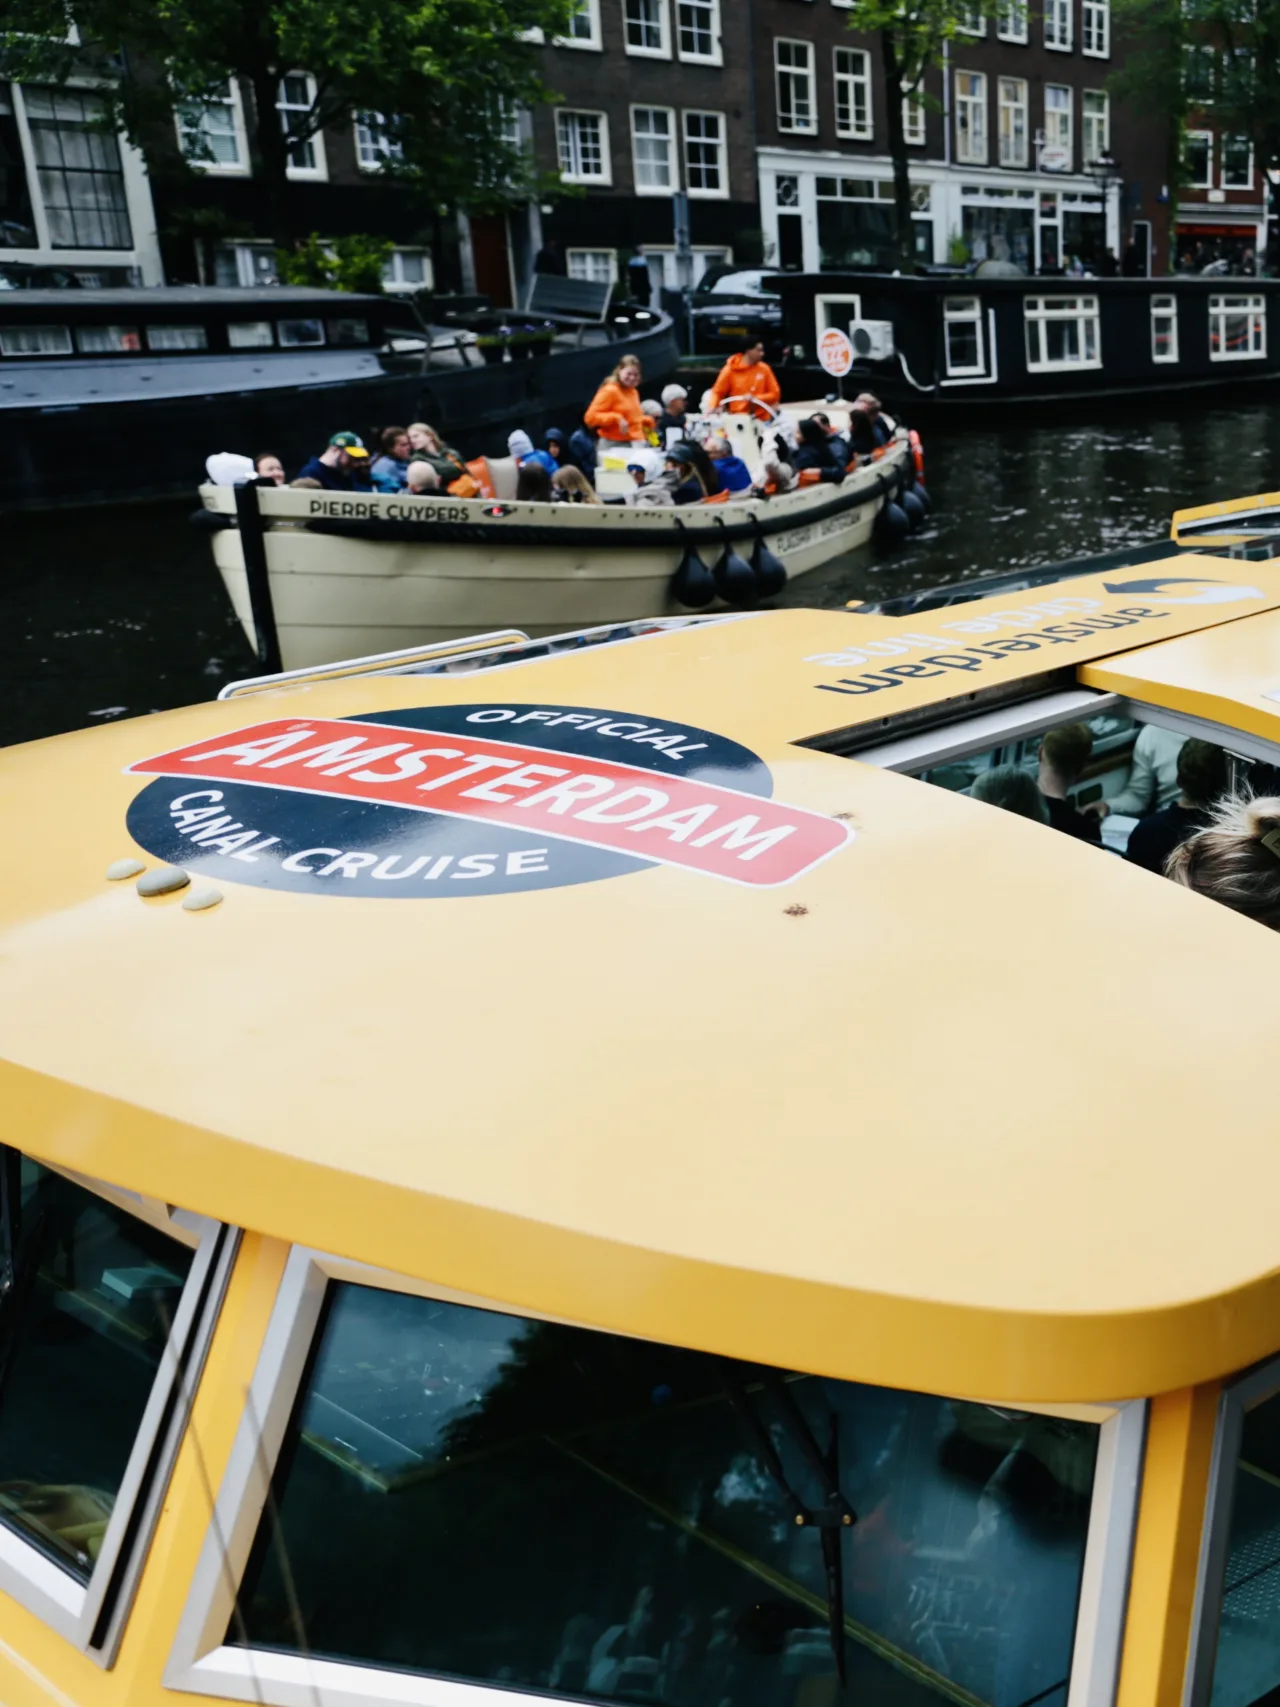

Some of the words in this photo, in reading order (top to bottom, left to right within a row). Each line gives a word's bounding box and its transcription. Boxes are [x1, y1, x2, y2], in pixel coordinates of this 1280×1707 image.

[310, 500, 380, 519] PIERRE
[387, 504, 470, 522] CUYPERS
[939, 597, 1105, 633] circle
[801, 633, 965, 667] line
[813, 607, 1172, 695] amsterdam
[465, 709, 708, 761] OFFICIAL
[180, 730, 798, 861] AMSTERDAM
[169, 789, 281, 863] CANAL
[281, 847, 549, 881] CRUISE
